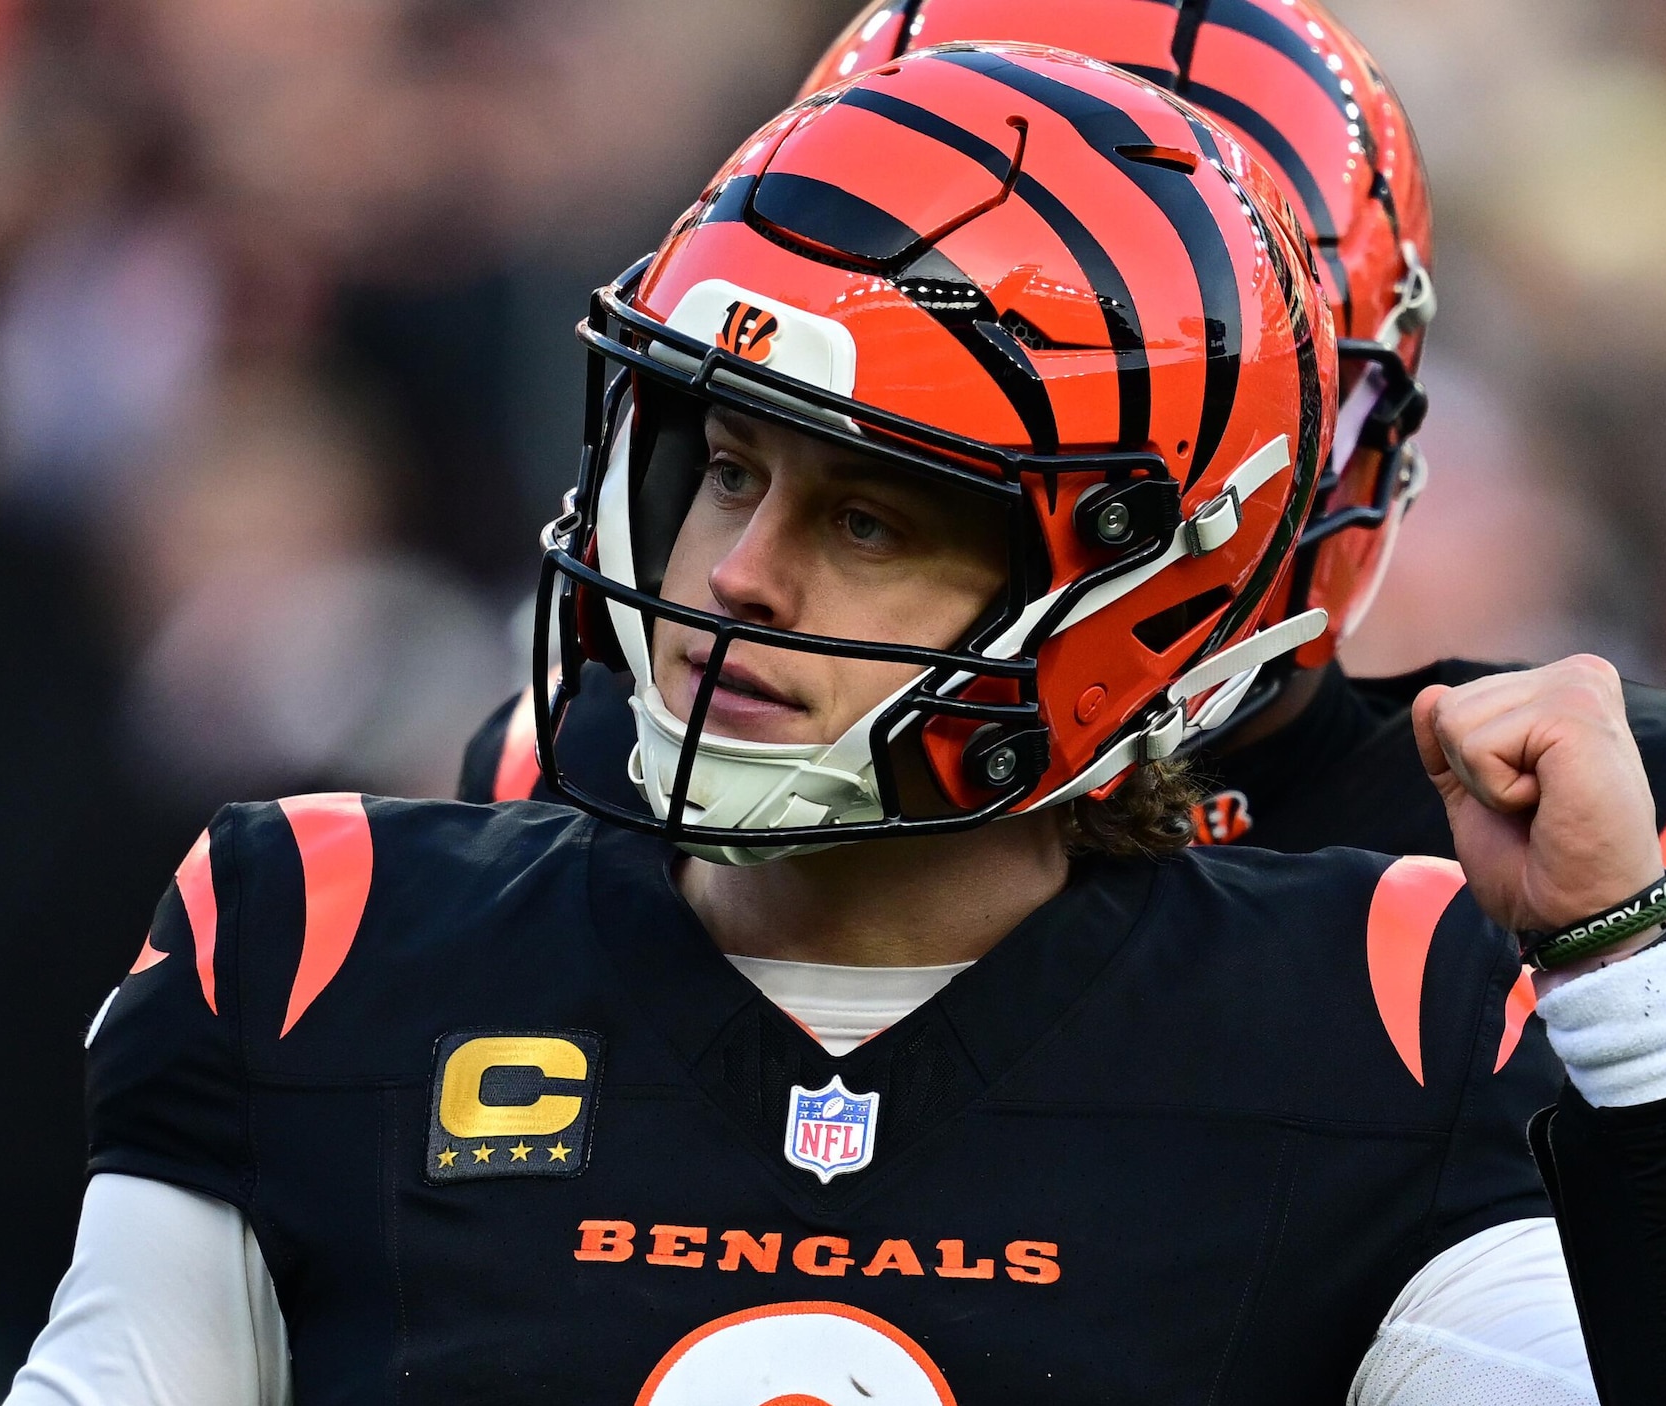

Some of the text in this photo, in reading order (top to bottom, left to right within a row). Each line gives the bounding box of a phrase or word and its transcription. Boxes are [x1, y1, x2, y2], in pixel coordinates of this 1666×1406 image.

[439, 1036, 588, 1139] C
[799, 1122, 858, 1163] NFL
[573, 1219, 1062, 1285] BENGALS
